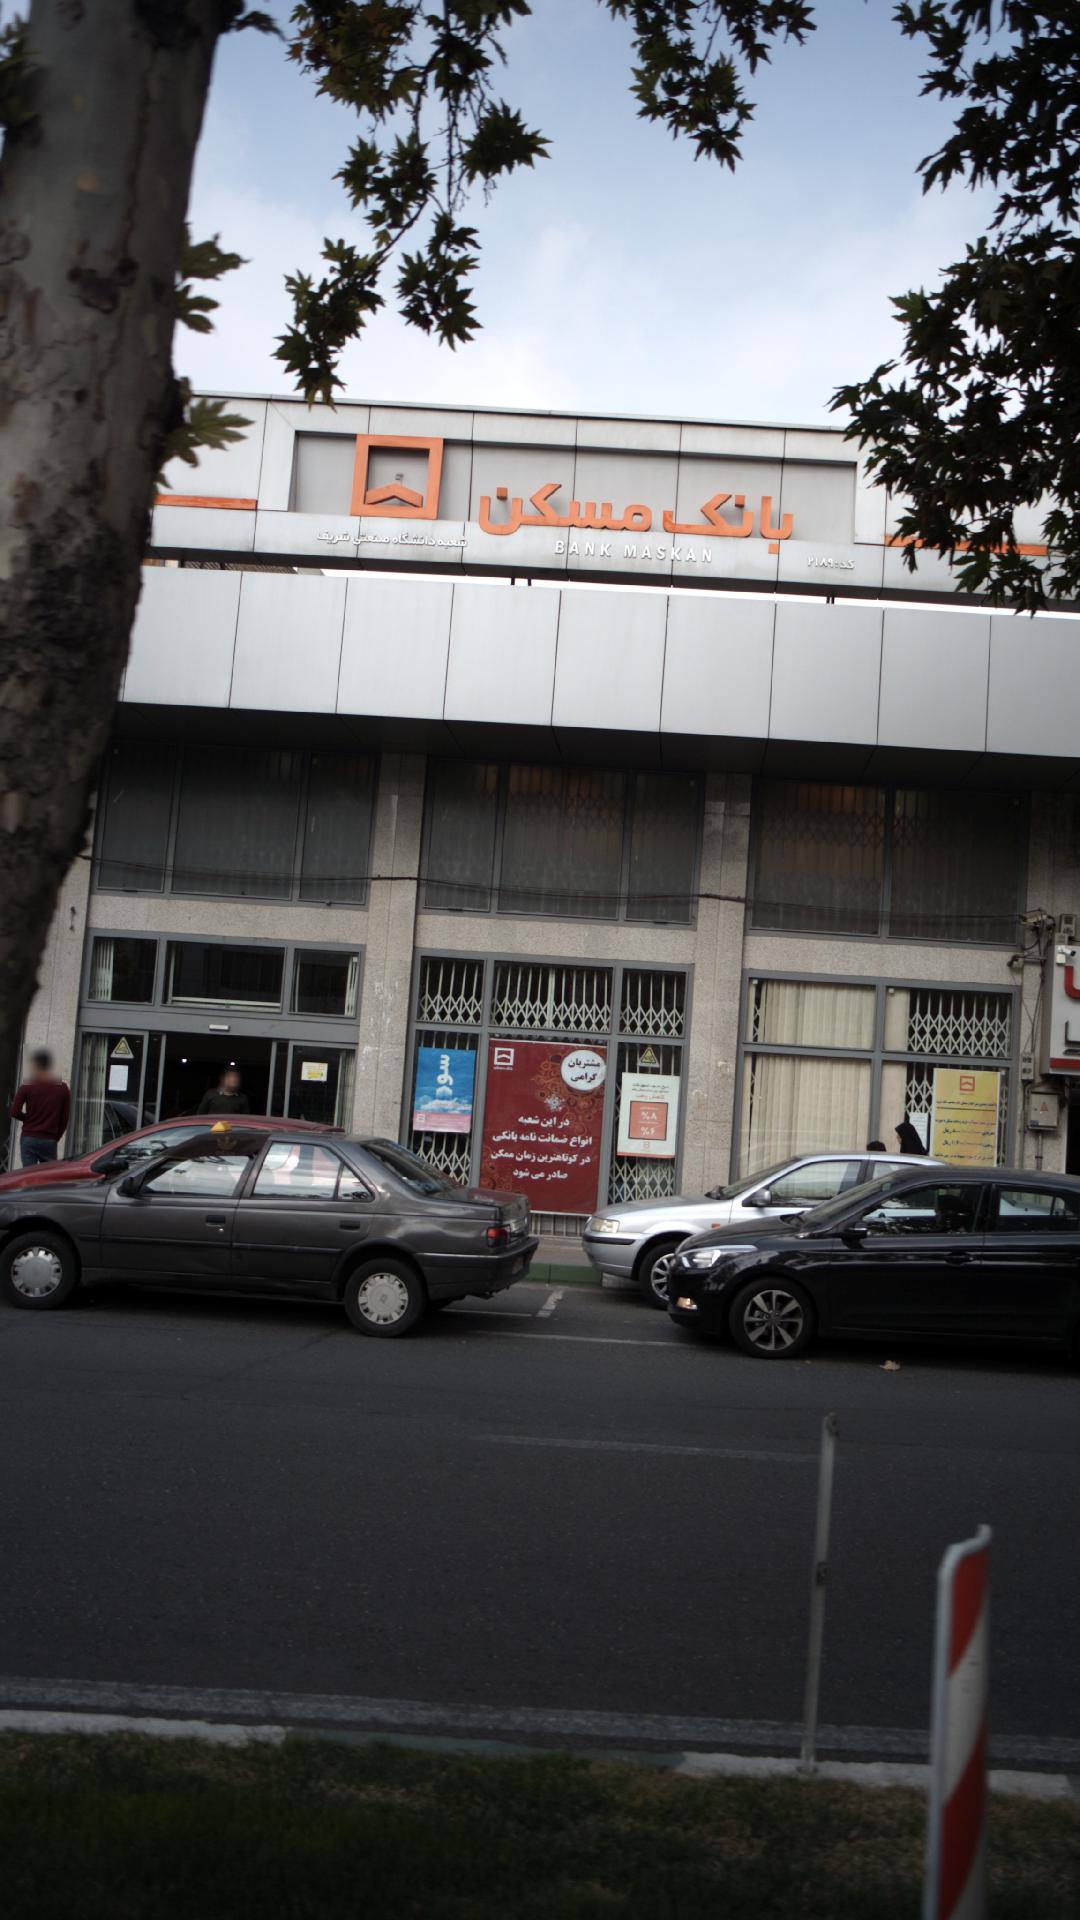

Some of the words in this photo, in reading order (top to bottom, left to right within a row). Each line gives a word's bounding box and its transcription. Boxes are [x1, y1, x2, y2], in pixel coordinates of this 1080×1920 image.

[479, 483, 652, 535] مسکن
[662, 493, 794, 554] بانک
[316, 529, 351, 545] شریف
[353, 533, 390, 546] صنعتی
[391, 531, 436, 547] دانشگاه
[437, 537, 469, 550] شعبه
[555, 540, 612, 558] BANK
[624, 545, 713, 563] MASKAN
[567, 1058, 601, 1070] مشتریان
[570, 1072, 598, 1083] گرامی
[517, 1115, 541, 1126] شعبه
[540, 1116, 558, 1128] این
[557, 1118, 571, 1129] در
[492, 1131, 518, 1143] بانکی
[519, 1131, 537, 1142] نامه
[538, 1132, 568, 1144] ضمانت
[569, 1136, 593, 1148] انواع
[490, 1149, 515, 1160] ممکن
[515, 1151, 536, 1163] زمان
[579, 1155, 592, 1166] در
[512, 1168, 530, 1180] شود
[530, 1172, 546, 1180] می
[545, 1170, 569, 1181] صادر
